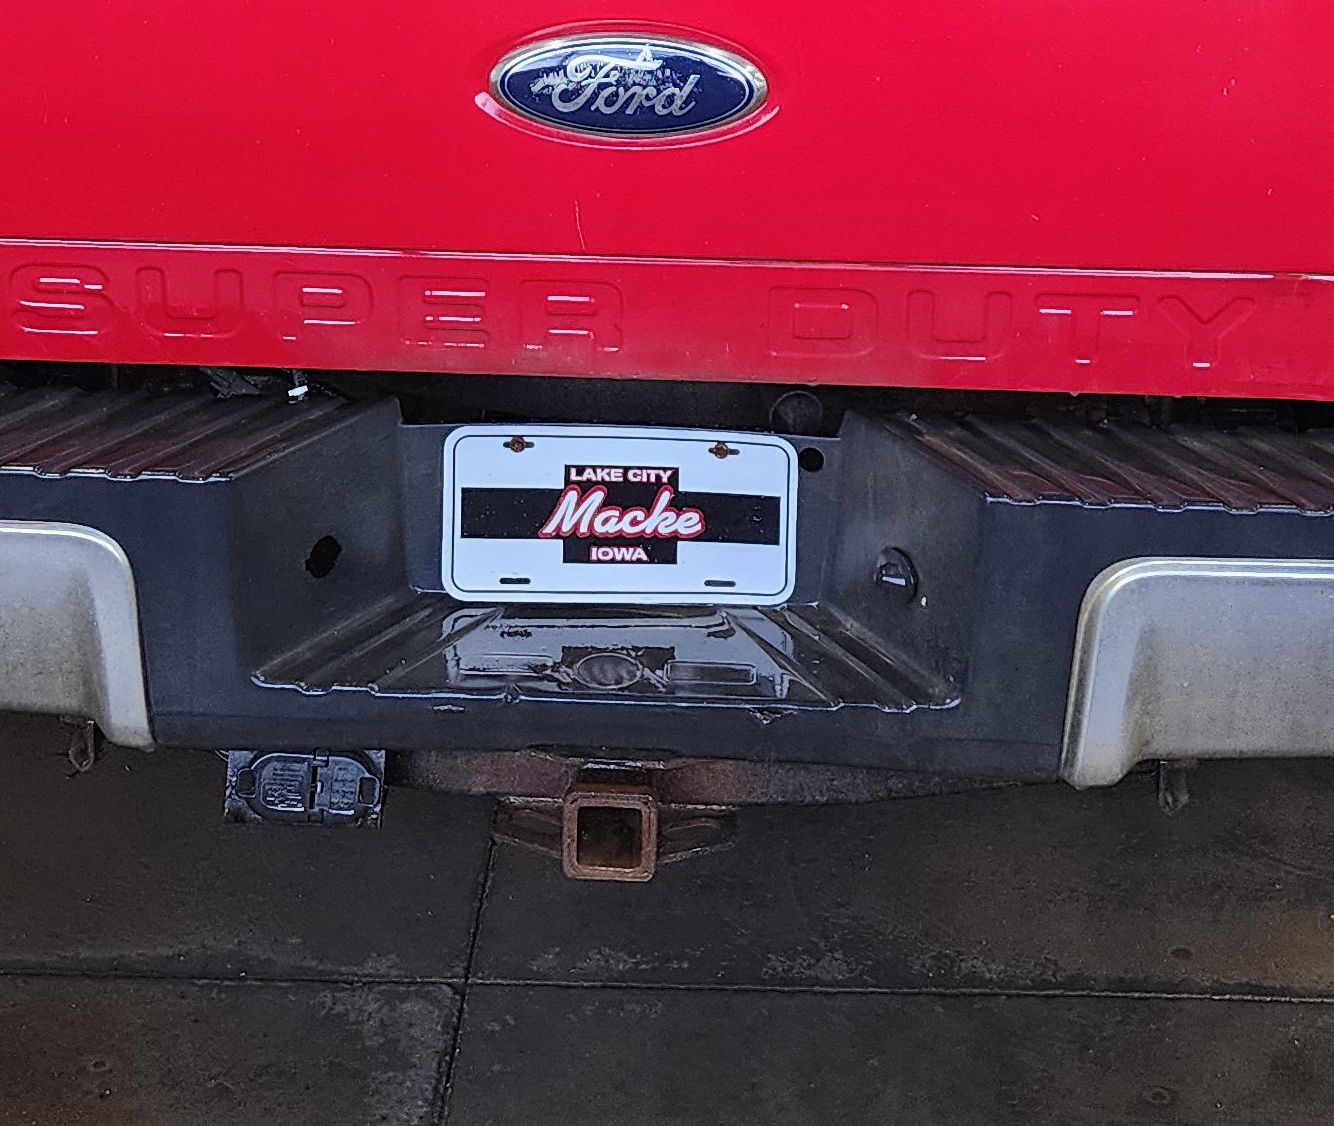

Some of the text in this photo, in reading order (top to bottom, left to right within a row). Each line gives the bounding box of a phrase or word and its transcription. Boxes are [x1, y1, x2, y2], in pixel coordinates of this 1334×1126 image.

[550, 54, 701, 116] Ford
[8, 261, 1256, 369] SUPER DUTY
[570, 467, 672, 483] LAKE CITY
[540, 485, 705, 538] Macke
[591, 547, 648, 562] IOWA
